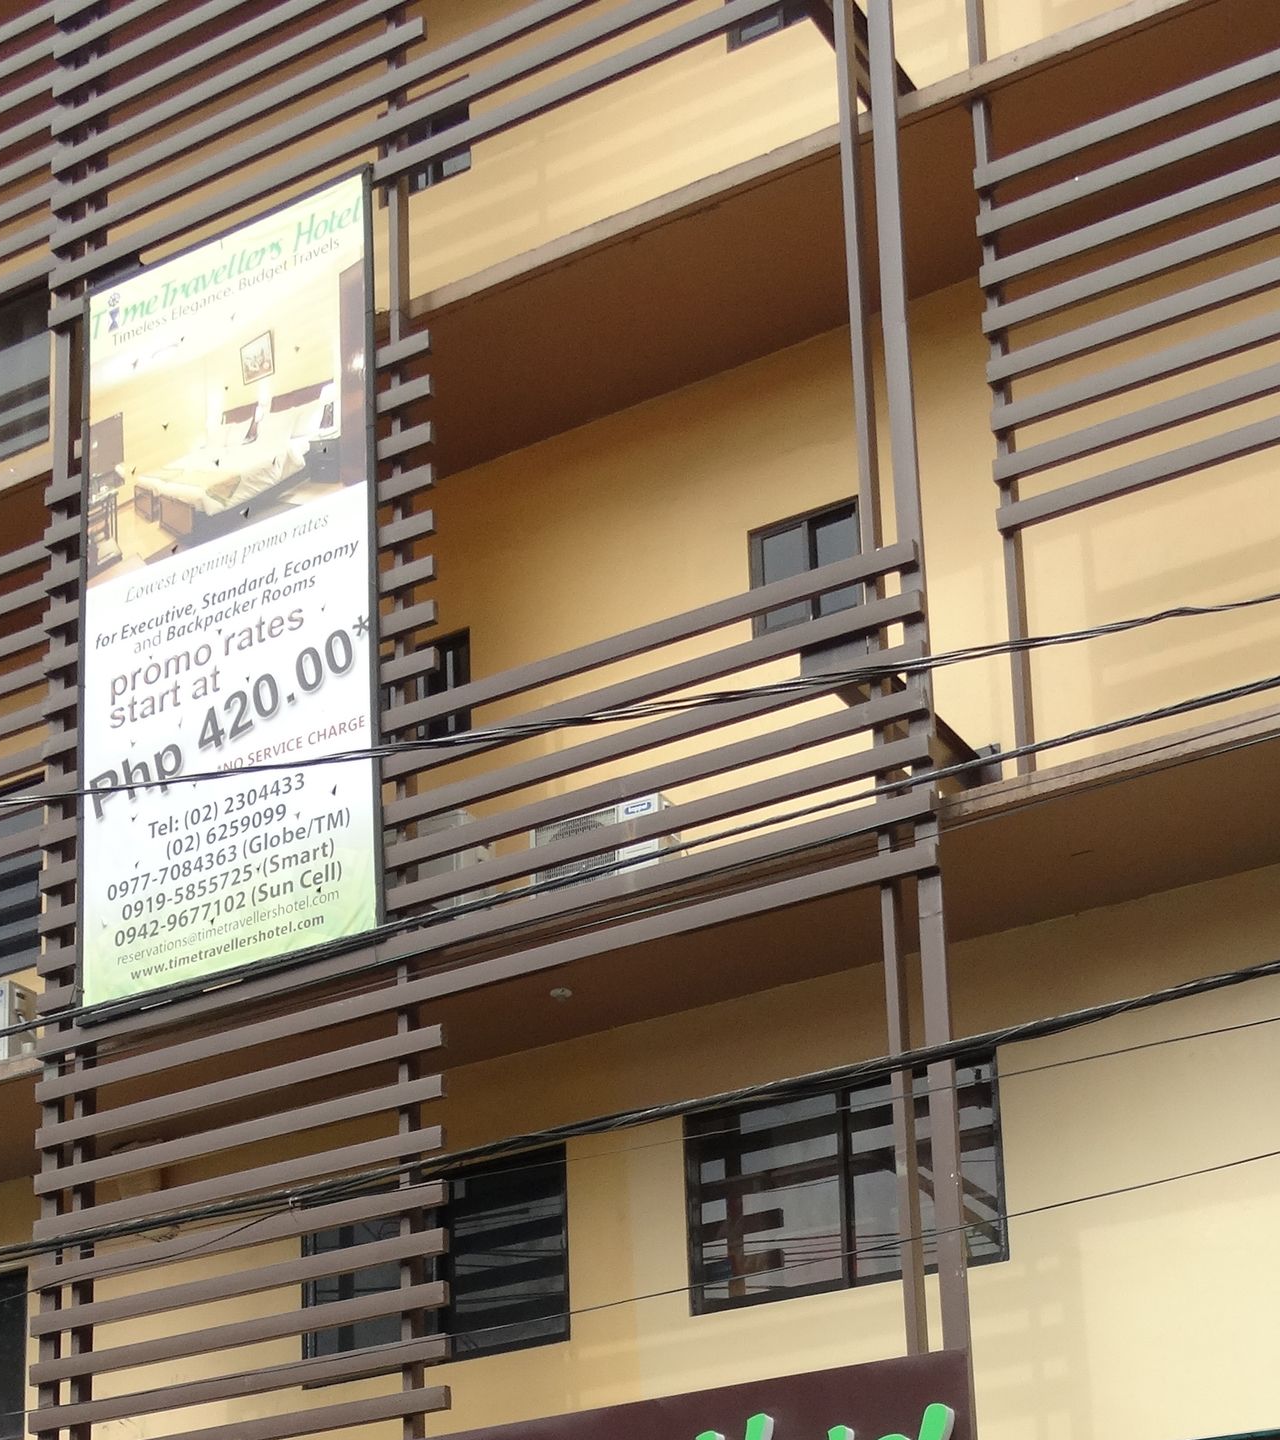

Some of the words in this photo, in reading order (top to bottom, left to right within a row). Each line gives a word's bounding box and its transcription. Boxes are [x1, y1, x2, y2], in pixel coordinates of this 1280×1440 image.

[293, 194, 362, 254] Hotel
[112, 315, 167, 346] Timeless
[171, 288, 235, 321] Elegance.
[239, 261, 288, 292] Budget
[291, 237, 340, 267] Travels
[96, 630, 118, 650] for
[120, 603, 197, 640] Executive,
[203, 567, 279, 609] Standard,
[283, 539, 359, 578] Economy
[125, 571, 177, 603] Lowest
[182, 550, 237, 583] opening
[241, 532, 287, 564] promo
[292, 514, 329, 538] rates
[133, 631, 162, 654] and
[166, 595, 257, 642] Backpacker
[261, 575, 316, 605] Rooms
[110, 644, 212, 706] promo
[223, 607, 305, 657] rates
[109, 680, 181, 729] start
[191, 665, 221, 700] at
[89, 741, 183, 819] Php
[247, 735, 303, 767] SERVICE
[307, 715, 366, 747] CHARGE
[148, 817, 179, 839] Tel:
[184, 801, 219, 831] (02)
[224, 772, 305, 815] 2304433
[166, 831, 201, 861] (02)
[205, 803, 287, 845] 6259099
[107, 845, 237, 901] 0977-7084363
[242, 807, 351, 859] (Globe/TM)
[122, 864, 253, 921] 0919-5855725
[262, 838, 336, 878] (Smart)
[114, 892, 246, 948] 0942-9677102
[250, 879, 294, 907] (Sun
[300, 860, 343, 888] Cell)
[117, 888, 341, 967] reservations@timetravellershotel.com
[130, 913, 325, 980] www.timetravellershotel.com
